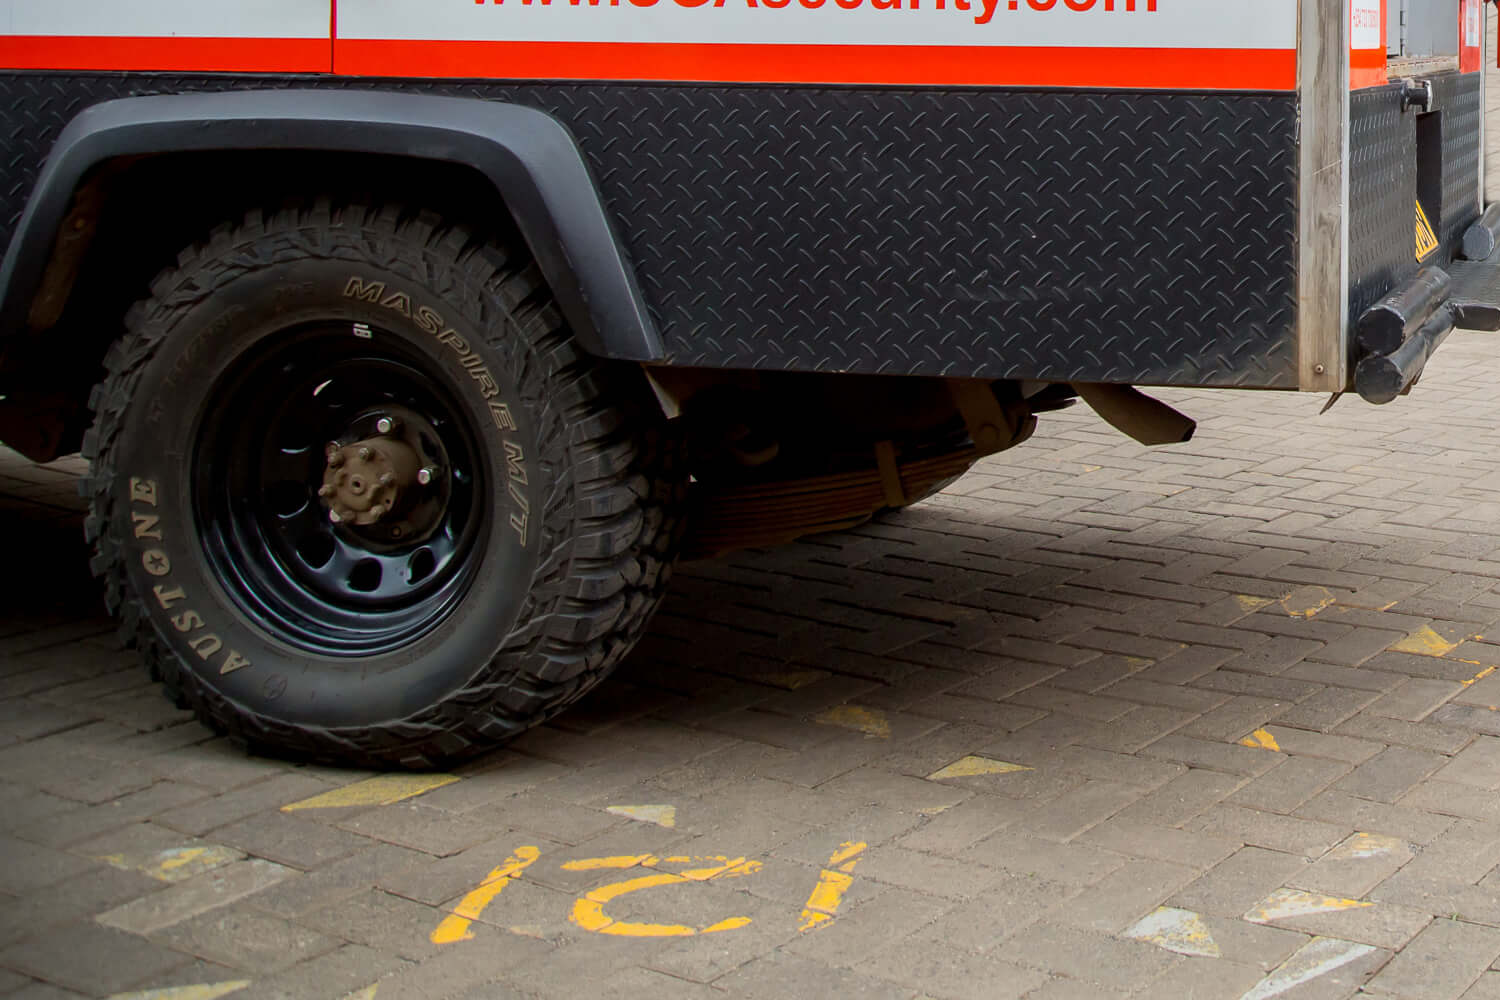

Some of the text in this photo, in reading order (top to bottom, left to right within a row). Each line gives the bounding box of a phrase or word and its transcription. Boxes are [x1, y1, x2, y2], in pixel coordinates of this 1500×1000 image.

[343, 276, 531, 548] MASPIRE M/T
[130, 476, 252, 675] AUSTONE
